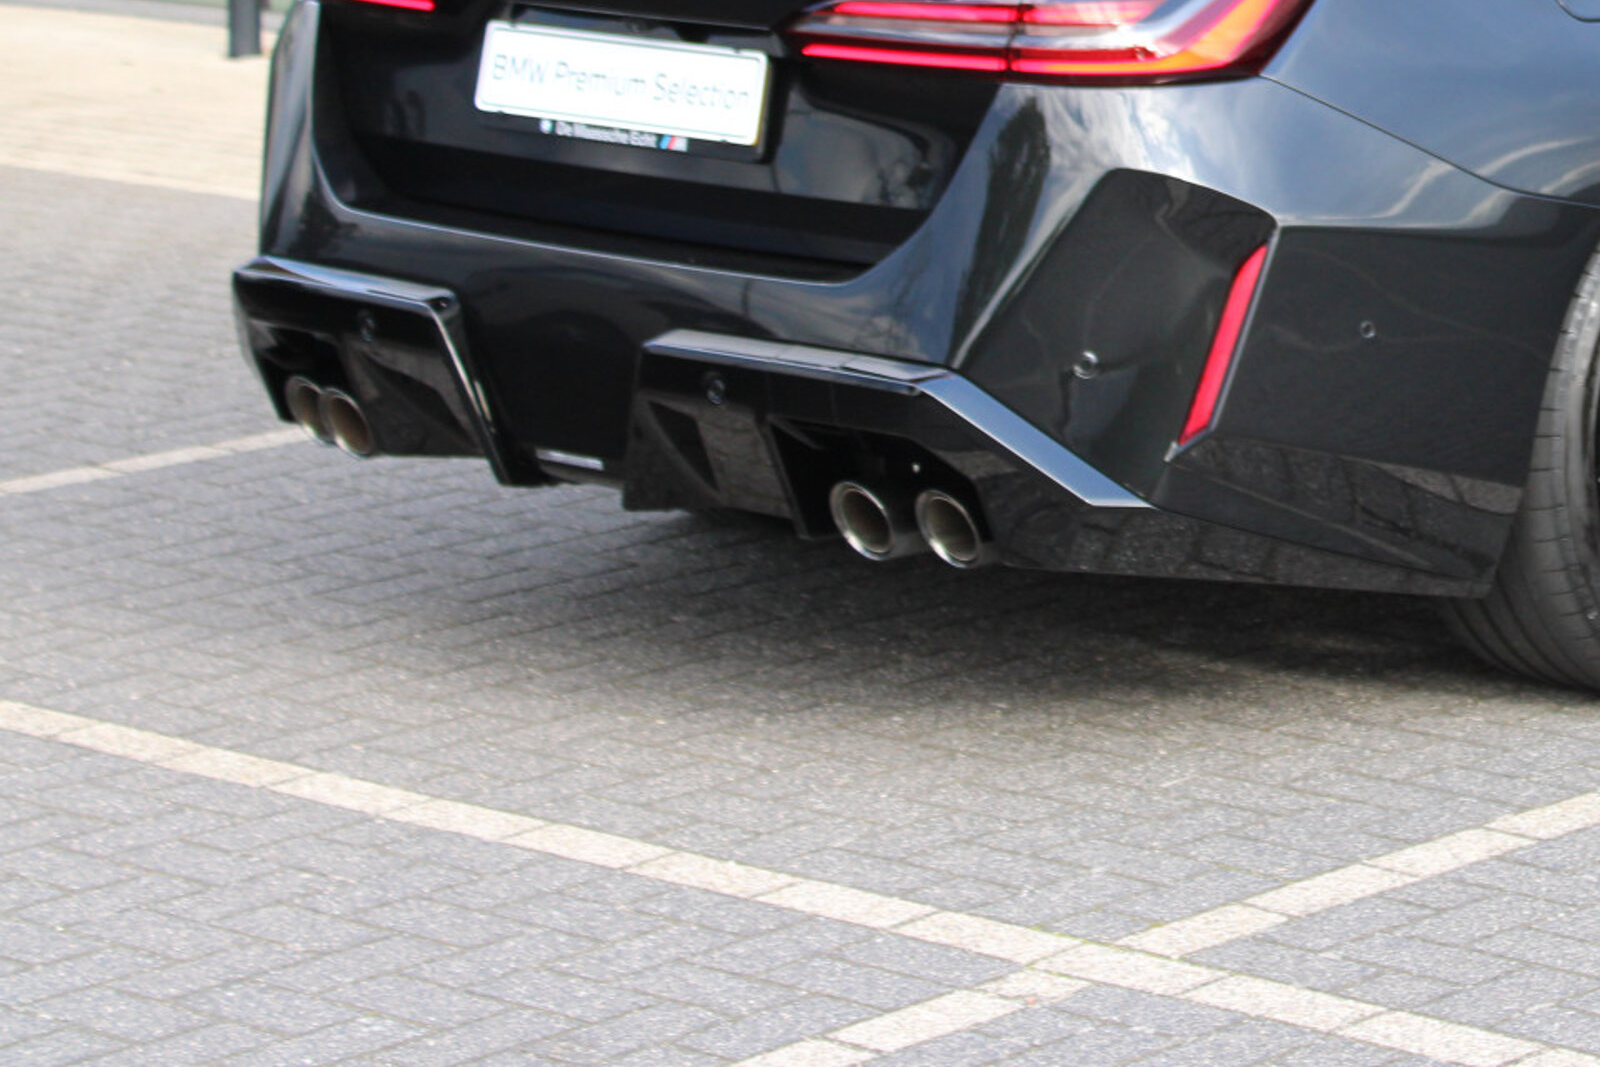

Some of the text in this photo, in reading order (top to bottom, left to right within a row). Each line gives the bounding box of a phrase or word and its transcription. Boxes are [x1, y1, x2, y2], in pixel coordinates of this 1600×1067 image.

[492, 53, 750, 110] BMW Premium Selection
